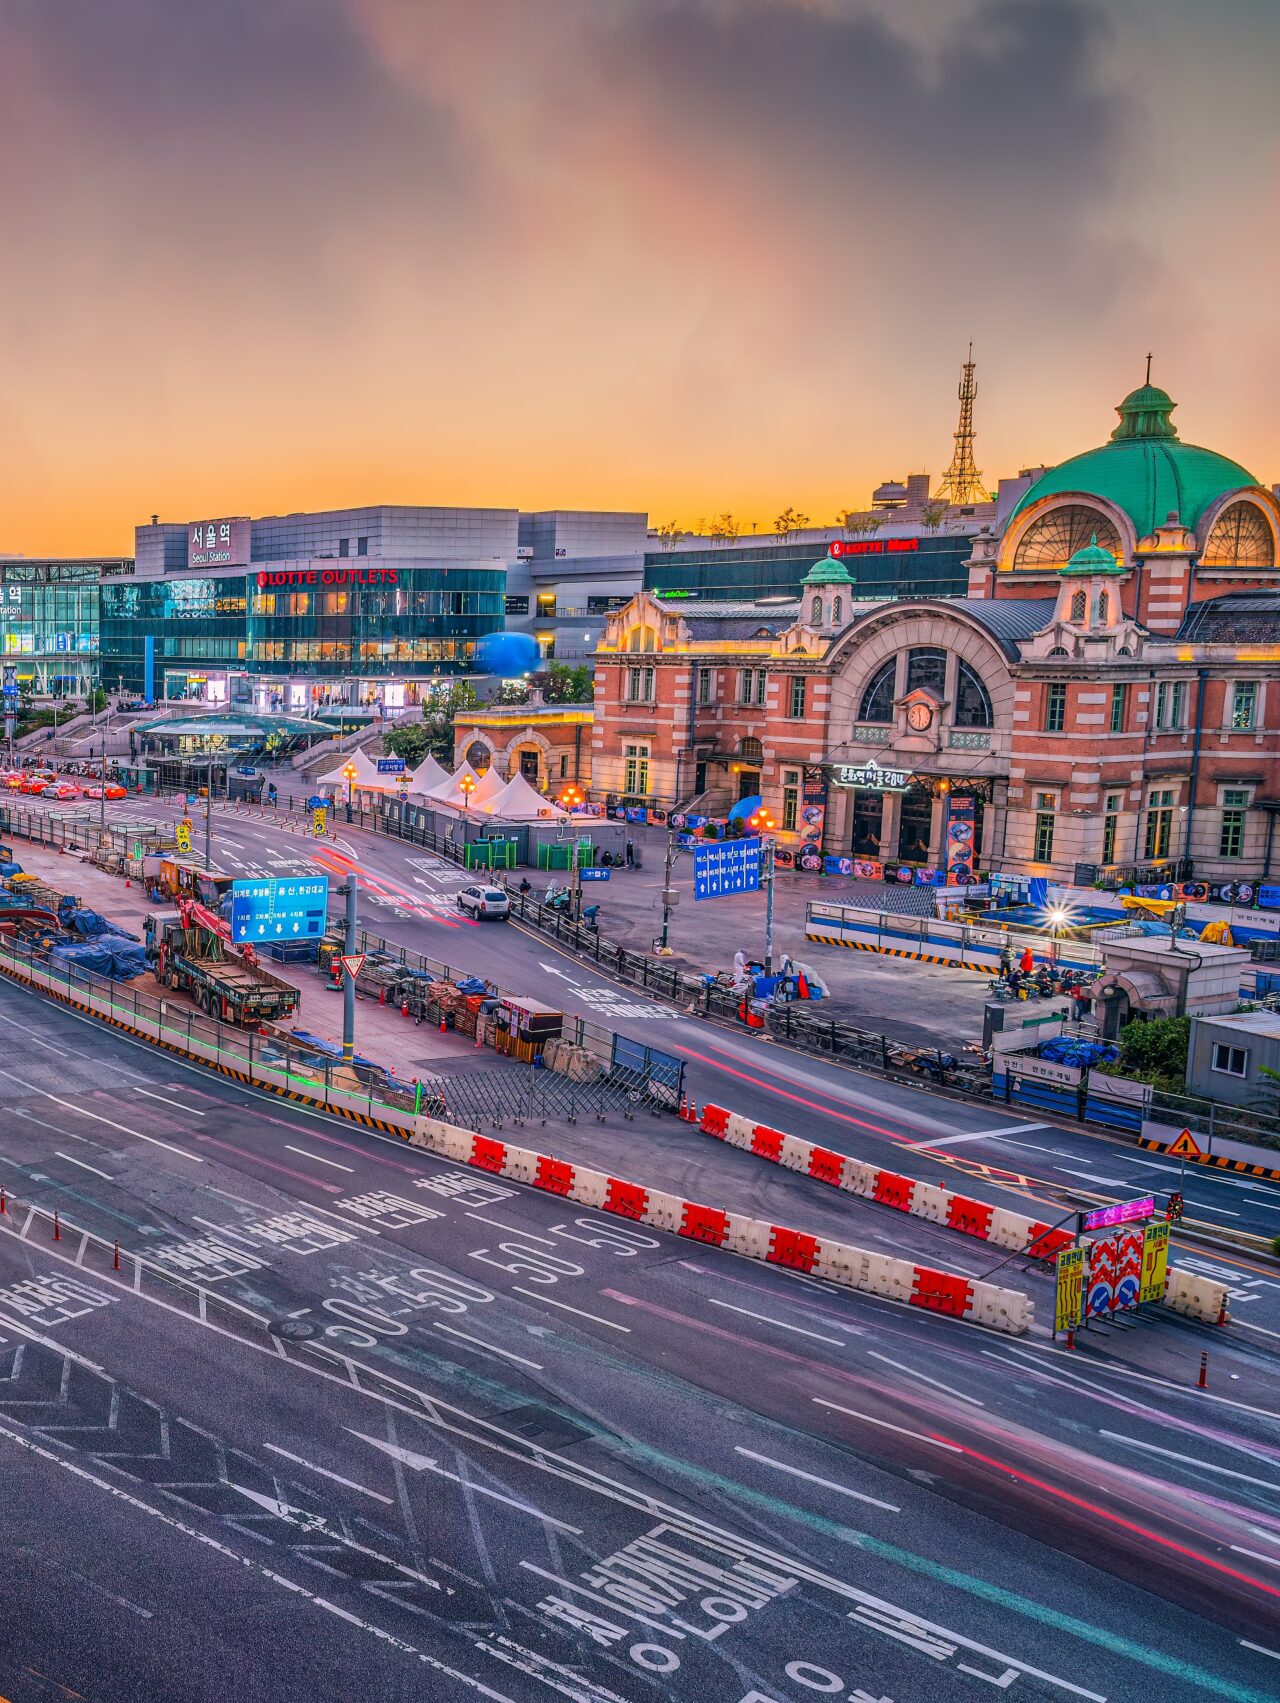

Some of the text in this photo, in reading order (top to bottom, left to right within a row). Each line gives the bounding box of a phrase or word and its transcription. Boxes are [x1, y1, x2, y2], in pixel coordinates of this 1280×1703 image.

[193, 524, 230, 549] 서울역
[843, 541, 884, 554] LOTTE
[193, 550, 231, 563] Seoul Station
[268, 568, 399, 586] LOTTE OUTLETS
[548, 1218, 662, 1257] 50
[467, 1241, 585, 1284] 50
[379, 1268, 495, 1314] 50
[580, 1522, 800, 1642] 한강대교
